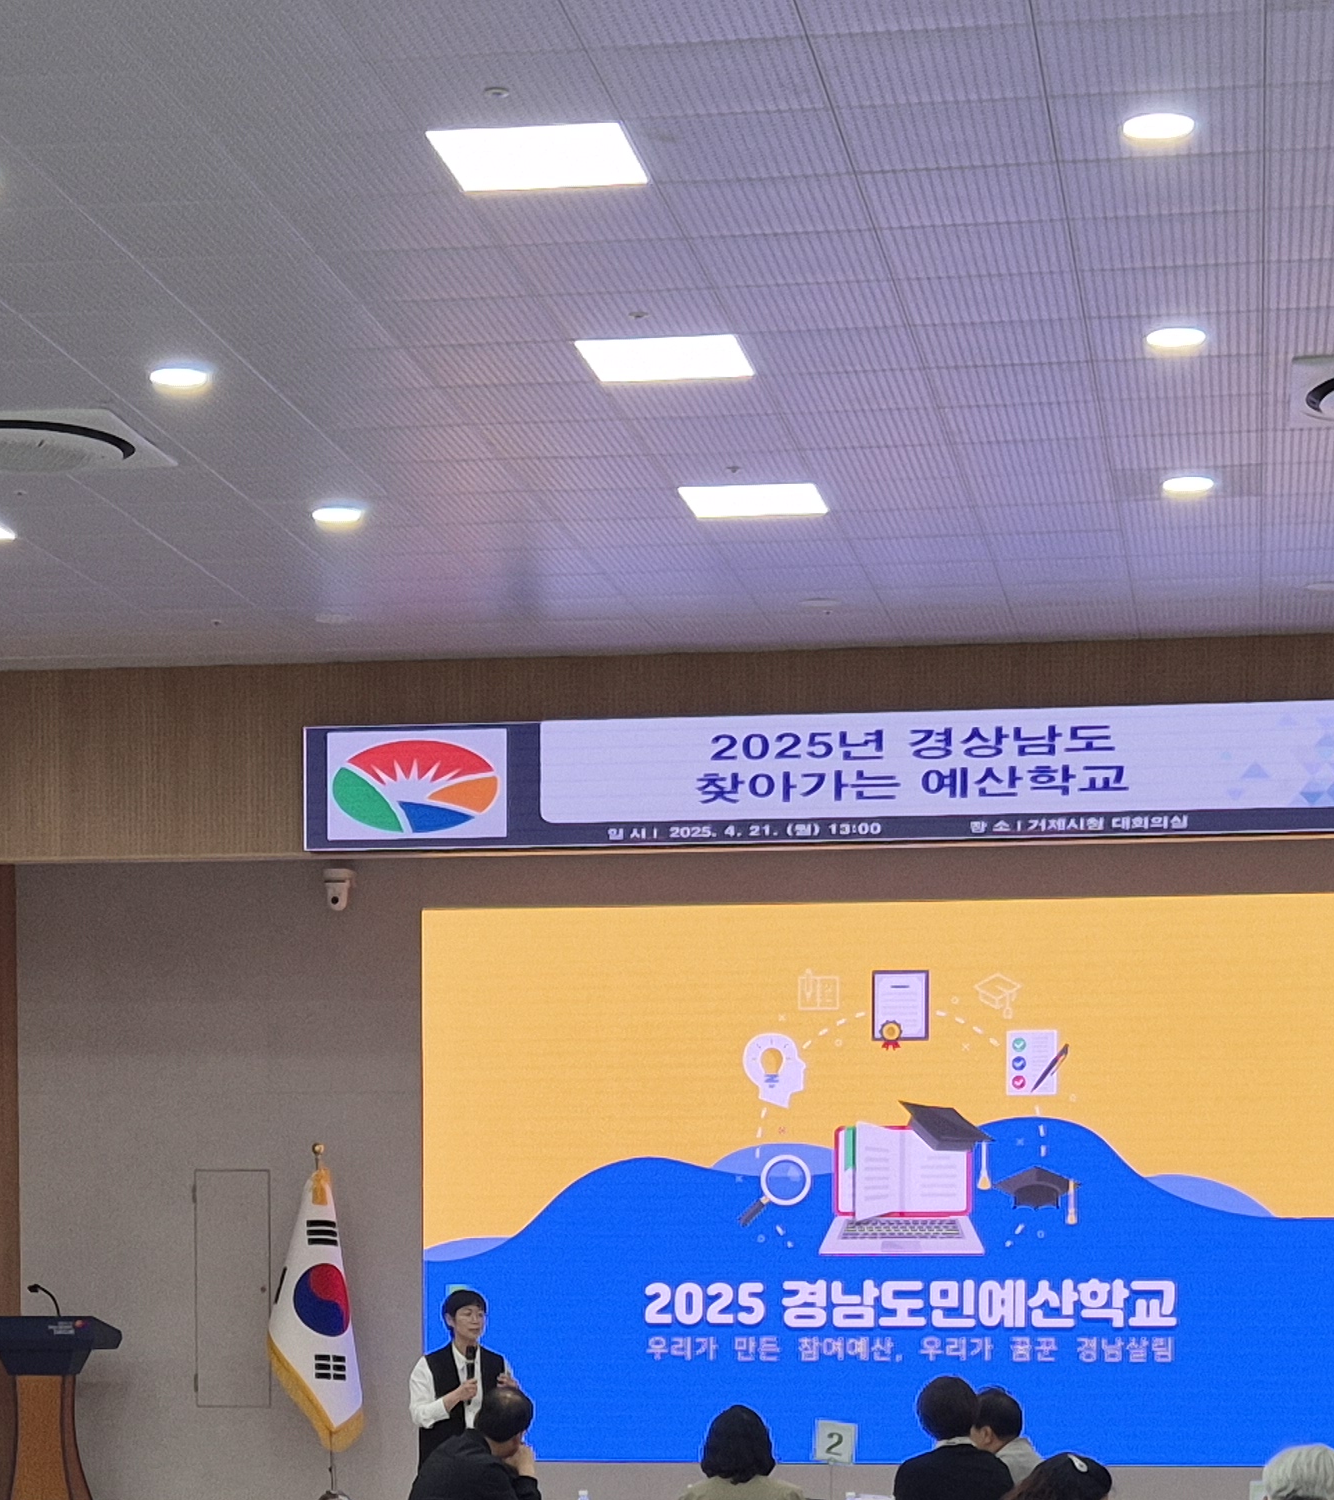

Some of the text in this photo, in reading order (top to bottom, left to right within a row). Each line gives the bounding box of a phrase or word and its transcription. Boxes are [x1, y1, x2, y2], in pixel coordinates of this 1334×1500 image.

[709, 724, 1116, 762] 2025년 경상남도
[695, 764, 1130, 804] 찾아가는 예산학교
[668, 825, 717, 838] 2025.
[723, 824, 743, 837] 4.
[748, 823, 779, 836] 21.
[828, 822, 883, 835] 13:00
[1027, 816, 1105, 832] 거제시청
[1111, 814, 1189, 830] 대회의실
[644, 1278, 1178, 1329] 2025 경남도민예산학교
[646, 1335, 1174, 1363] 우리가 만든 참여예산, 우리가 꿈꾼 경남살림
[825, 1432, 844, 1456] 2
